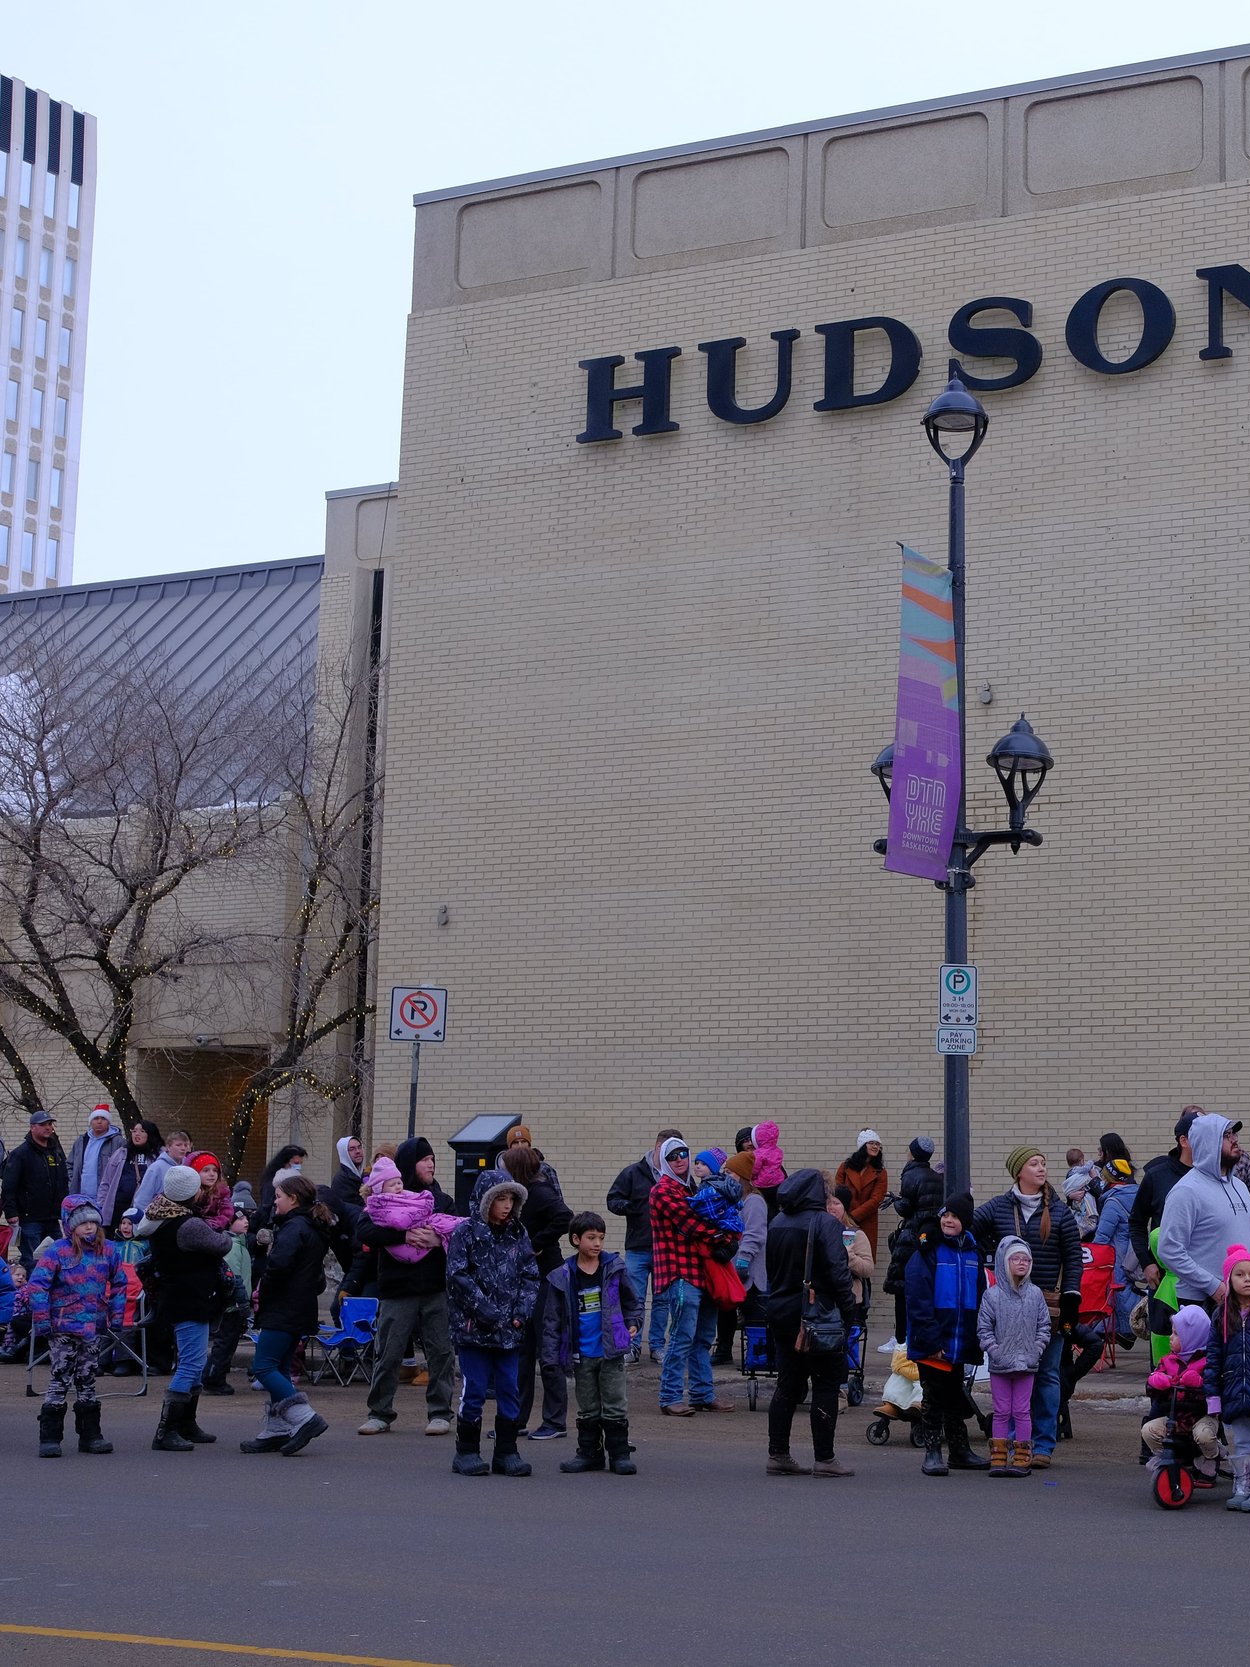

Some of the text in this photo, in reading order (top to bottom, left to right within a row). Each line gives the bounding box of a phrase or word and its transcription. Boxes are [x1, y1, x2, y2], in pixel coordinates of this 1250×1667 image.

[906, 774, 946, 808] DTN
[905, 802, 944, 835] YXE
[901, 840, 938, 855] SASKATOON
[902, 831, 940, 846] DOWNTOWN
[952, 974, 965, 990] P
[410, 1000, 428, 1020] P
